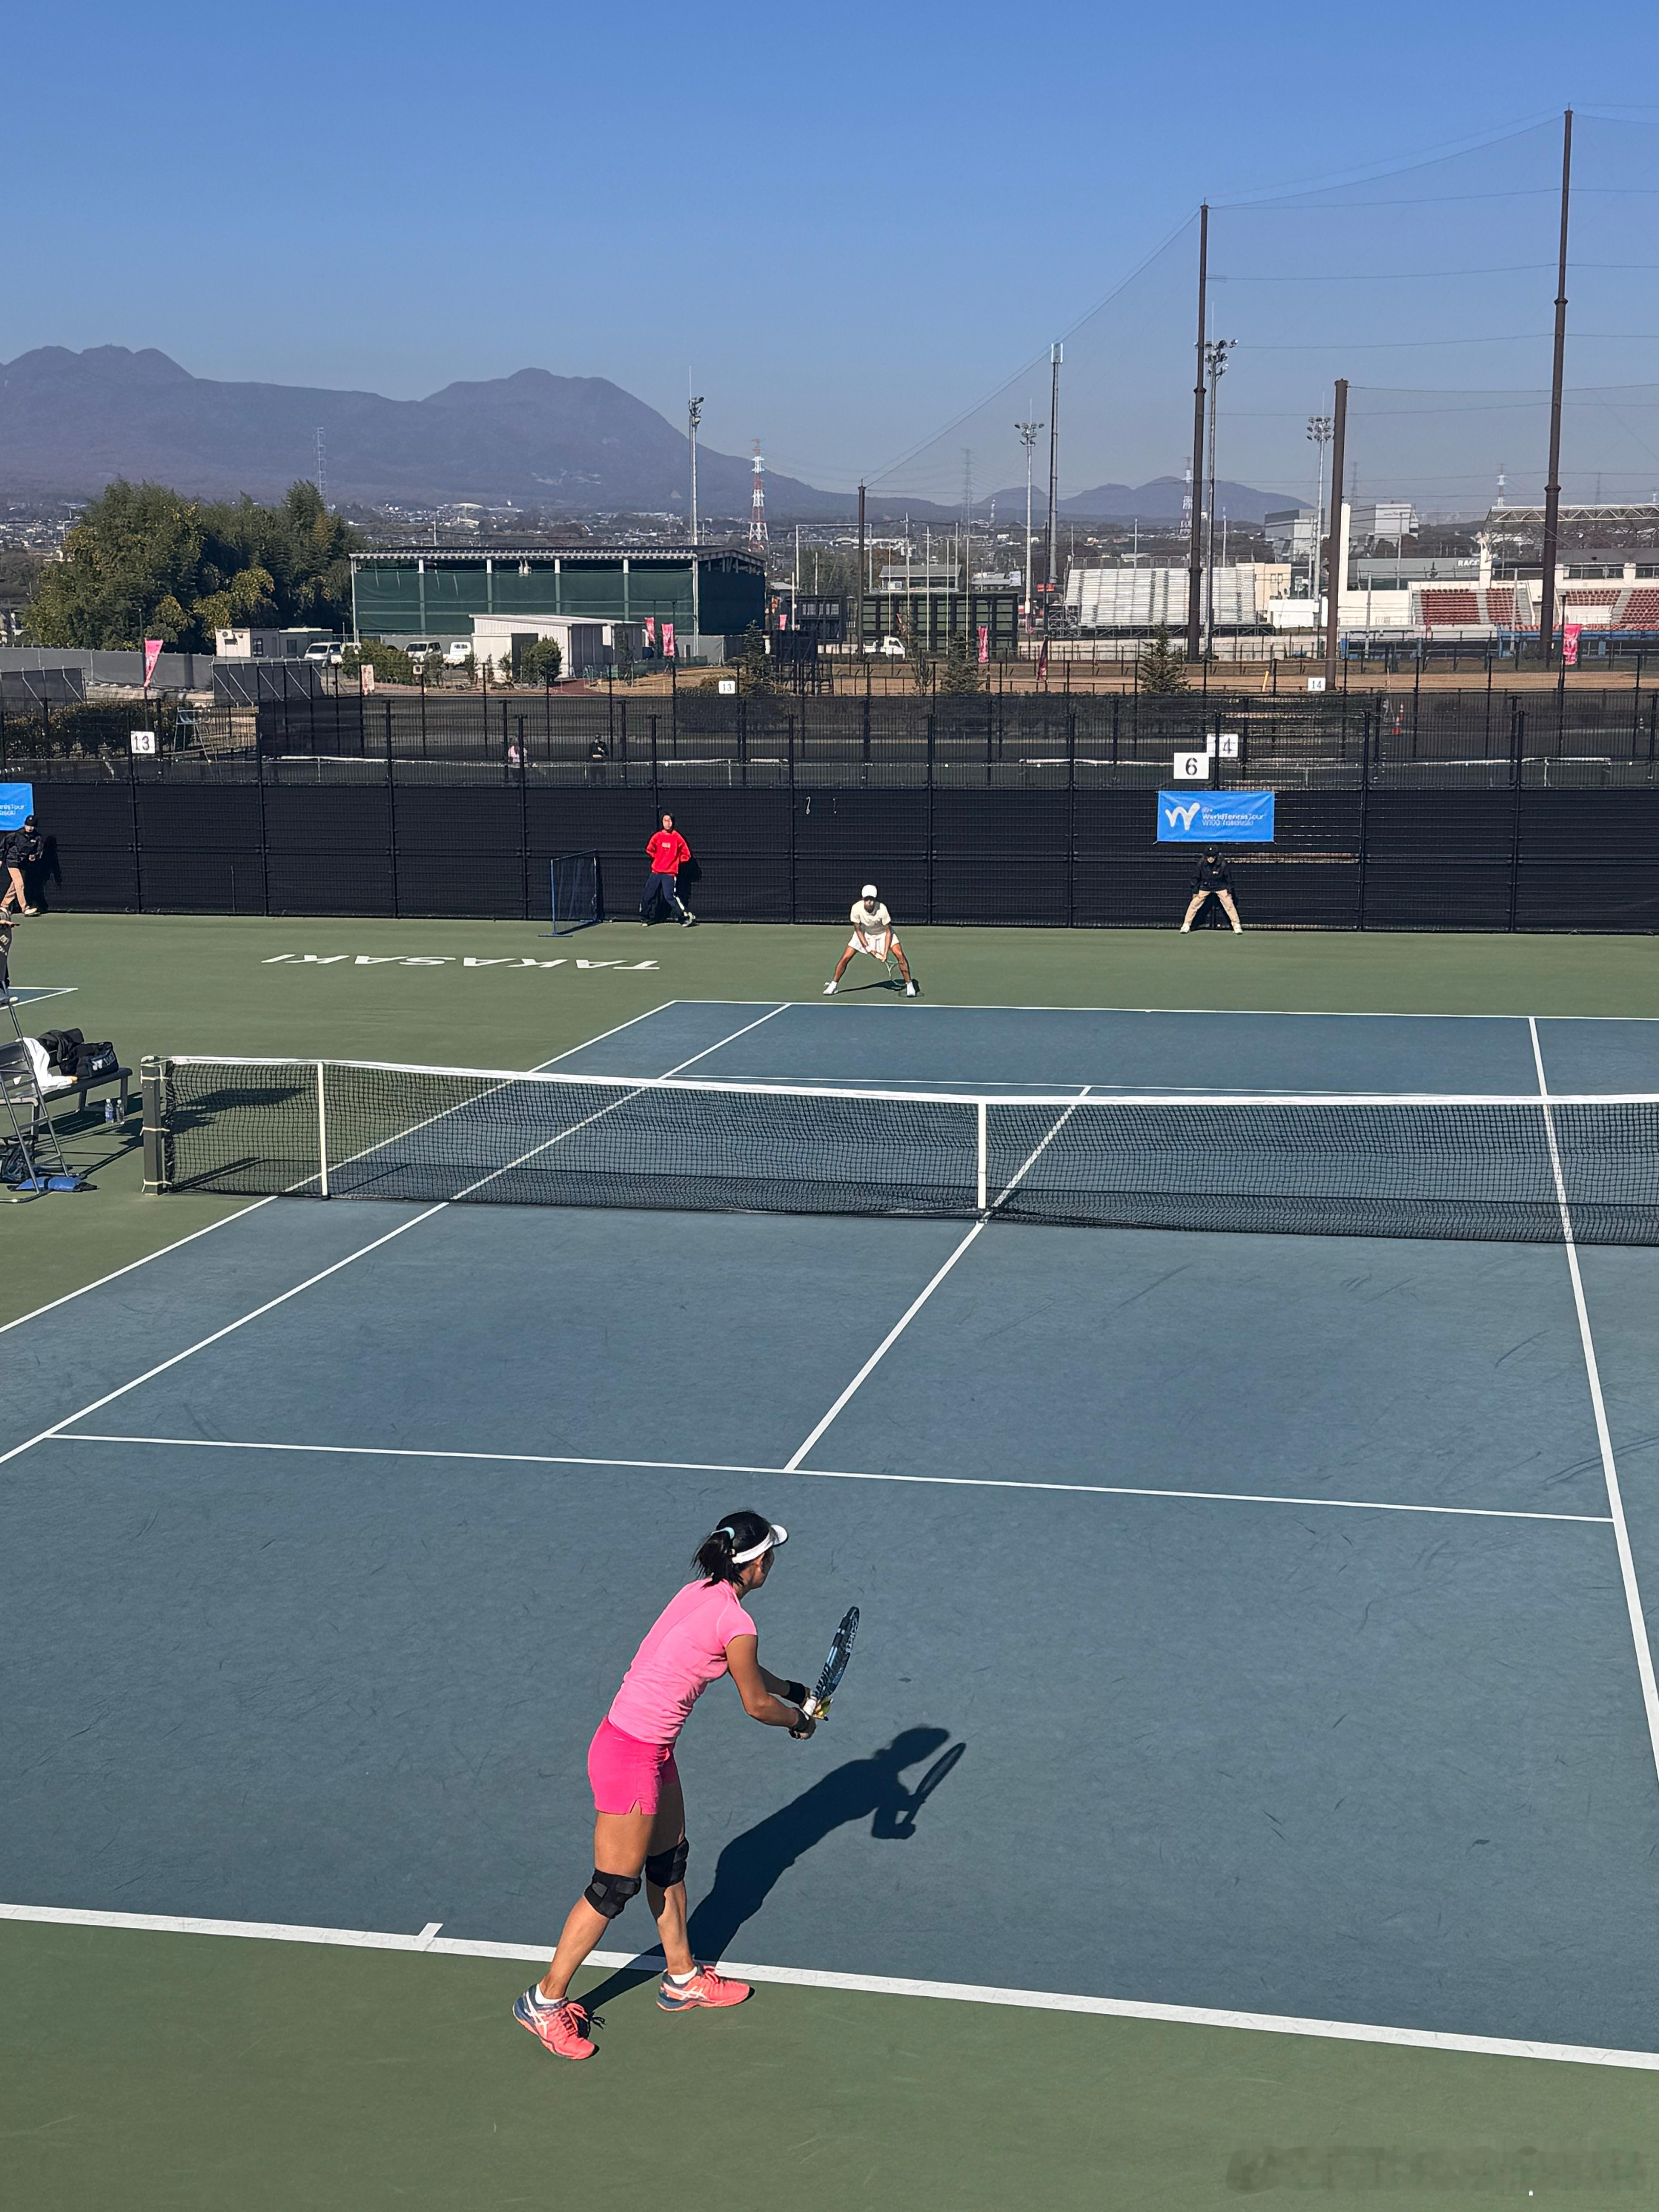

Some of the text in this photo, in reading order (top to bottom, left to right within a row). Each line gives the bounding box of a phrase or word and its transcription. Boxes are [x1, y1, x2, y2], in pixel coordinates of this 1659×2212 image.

[723, 684, 732, 692] 13
[1312, 680, 1322, 689] 14
[135, 735, 149, 750] 13
[1185, 757, 1198, 775] 6
[261, 954, 660, 970] TAKASAKI
